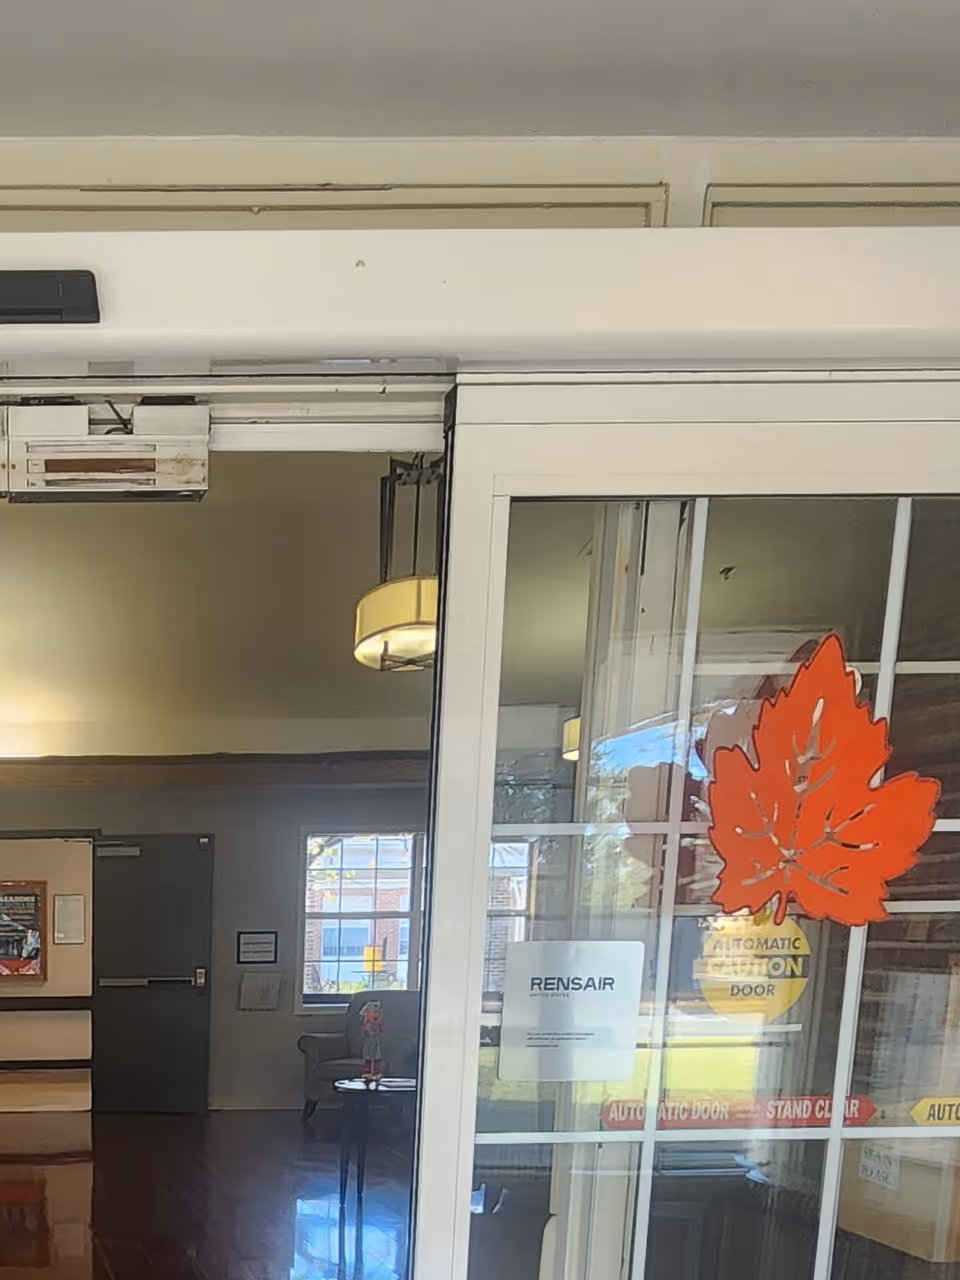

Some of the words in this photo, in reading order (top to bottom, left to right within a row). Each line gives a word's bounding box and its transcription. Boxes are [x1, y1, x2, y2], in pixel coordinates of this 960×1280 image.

[713, 937, 801, 951] AUTOMATIC
[530, 976, 615, 991] RENSAIR
[730, 984, 775, 997] DOOR
[608, 1101, 689, 1121] AUTOATIC
[691, 1101, 729, 1120] DOOR
[766, 1099, 811, 1120] STAND
[815, 1099, 859, 1119] CLR
